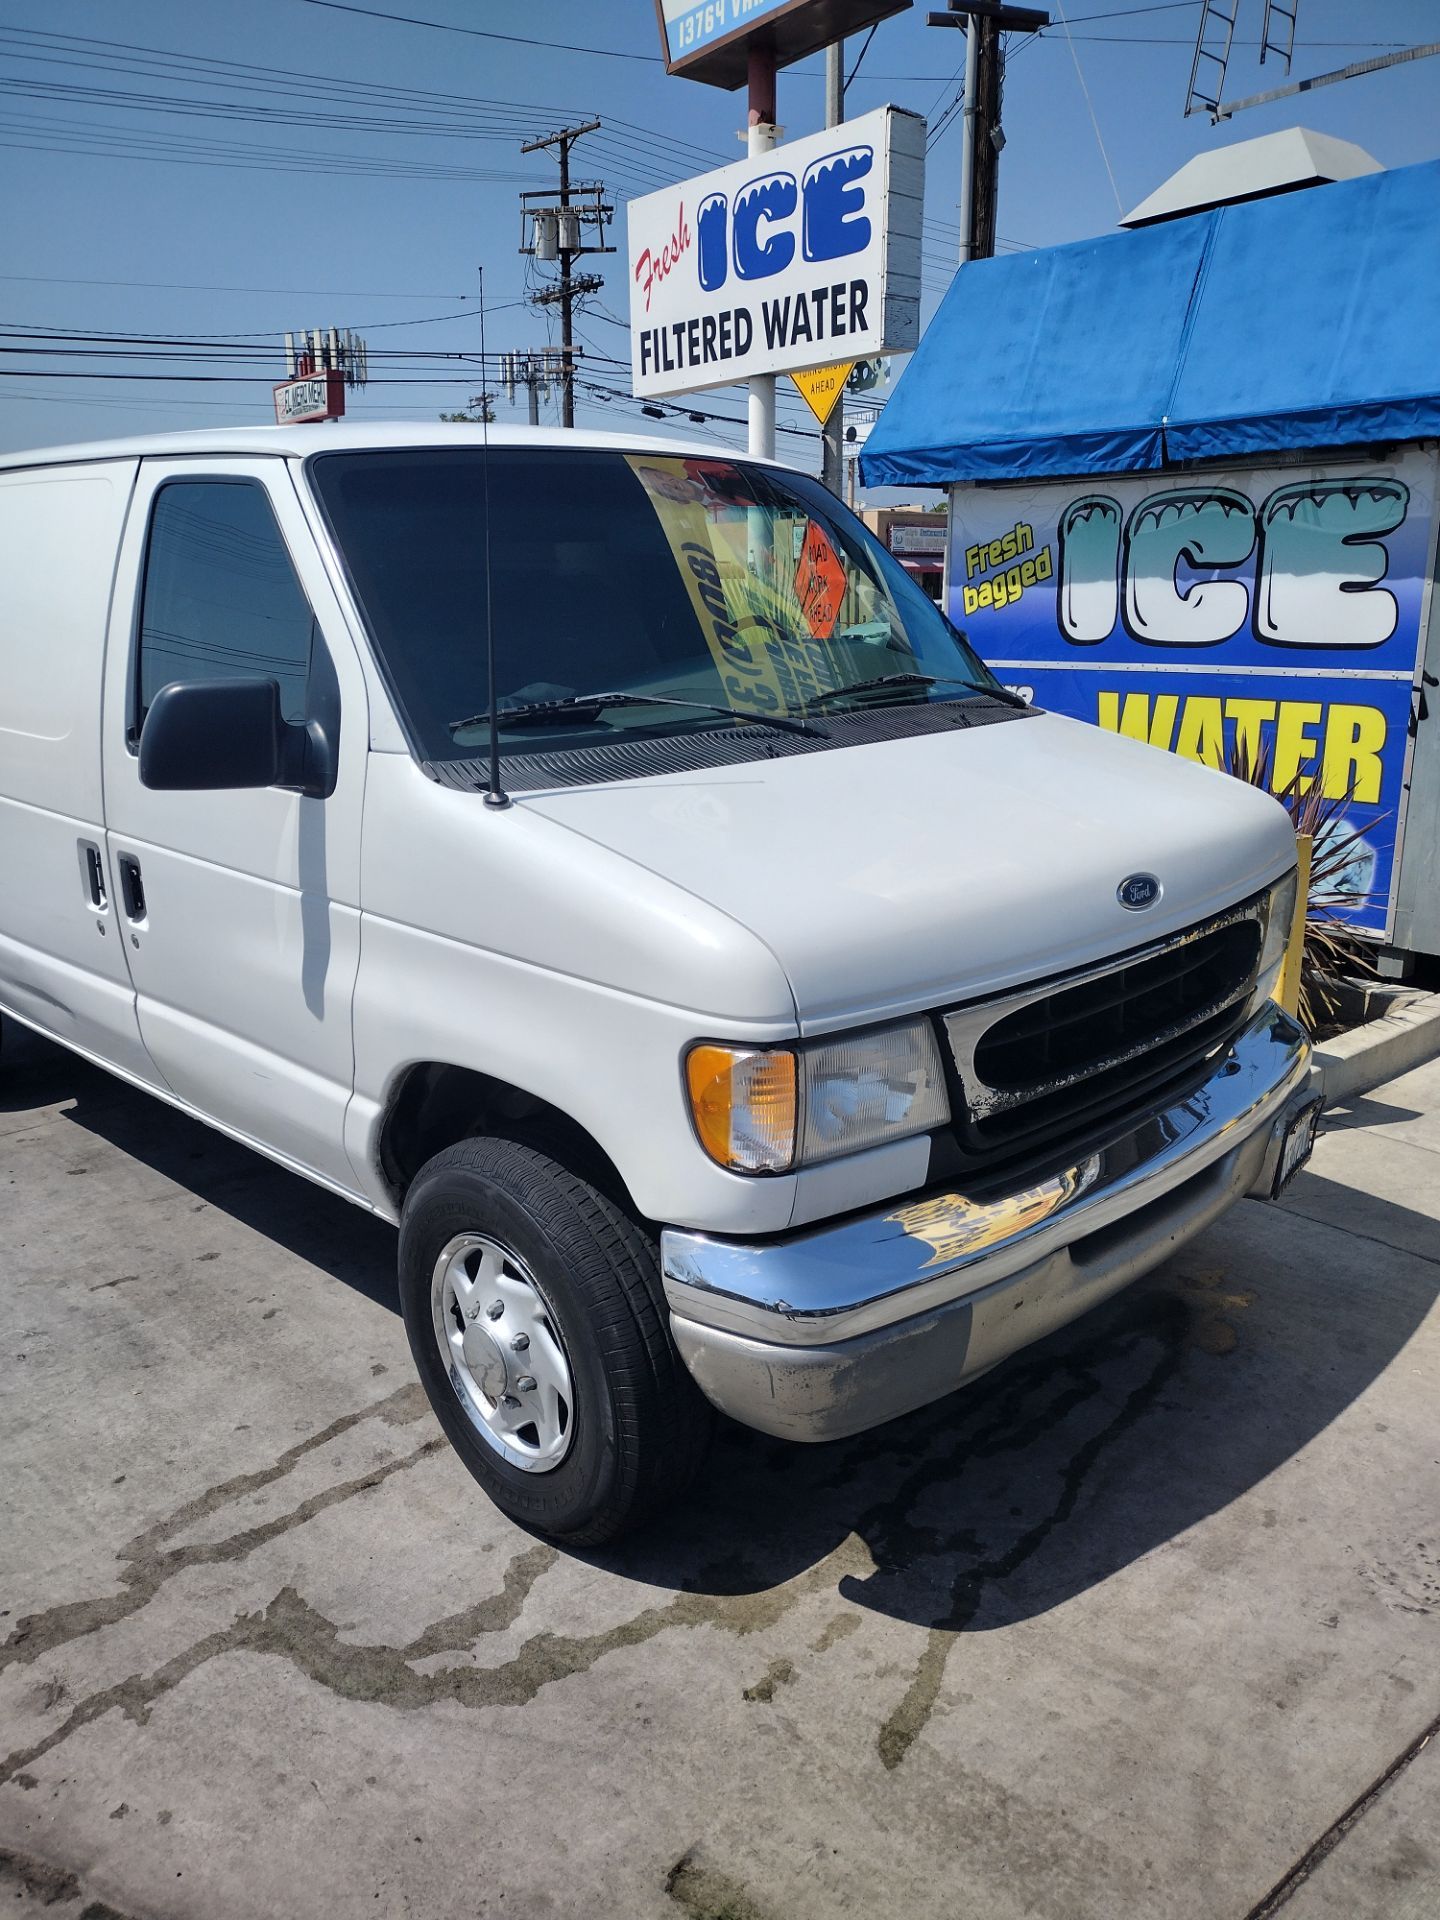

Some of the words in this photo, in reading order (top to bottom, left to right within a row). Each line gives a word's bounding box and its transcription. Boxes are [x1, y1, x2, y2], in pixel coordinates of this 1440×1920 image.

[679, 0, 725, 49] 13764
[635, 201, 691, 312] Fresh
[697, 145, 873, 292] ICE
[640, 307, 753, 376] FILTERED
[762, 279, 869, 351] WATER
[811, 378, 835, 395] AHEAD
[962, 545, 1054, 616] bagged
[963, 521, 1033, 580] Fresh
[1057, 477, 1411, 650] ICE
[1130, 882, 1151, 902] Ford
